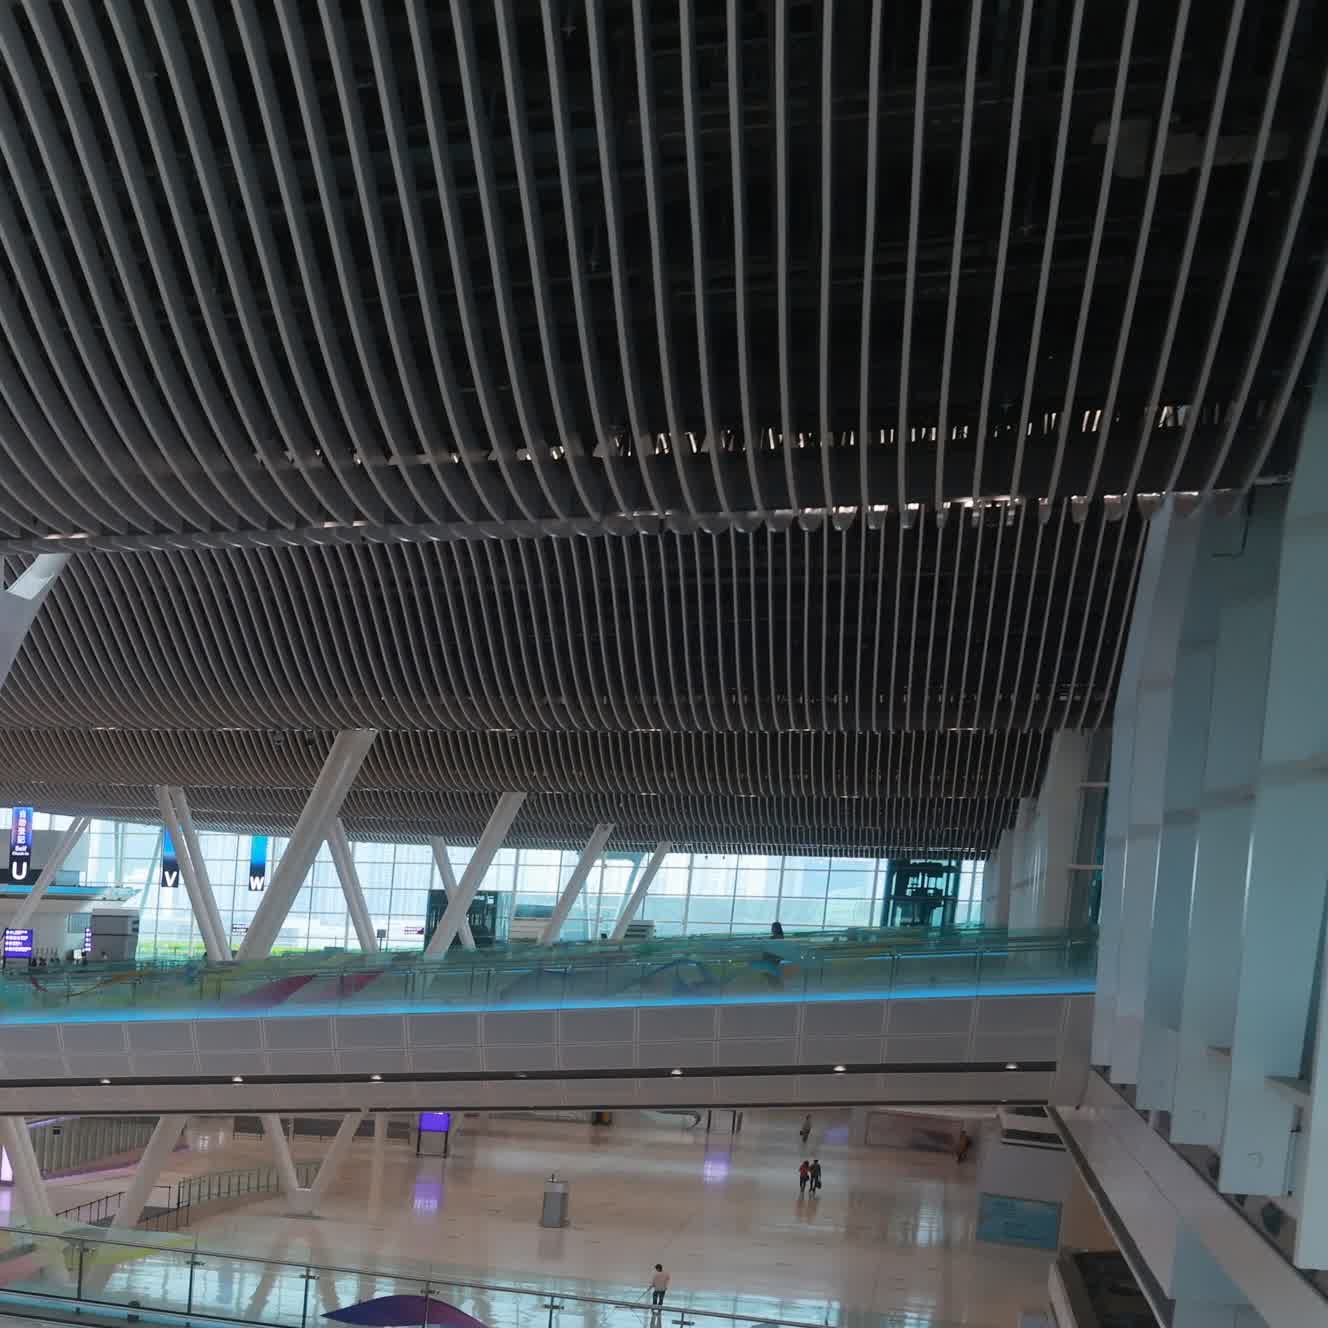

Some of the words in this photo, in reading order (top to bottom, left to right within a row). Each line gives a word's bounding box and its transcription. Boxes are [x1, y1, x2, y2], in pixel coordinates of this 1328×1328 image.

[12, 861, 27, 881] U
[164, 871, 177, 887] V
[249, 876, 265, 890] W
